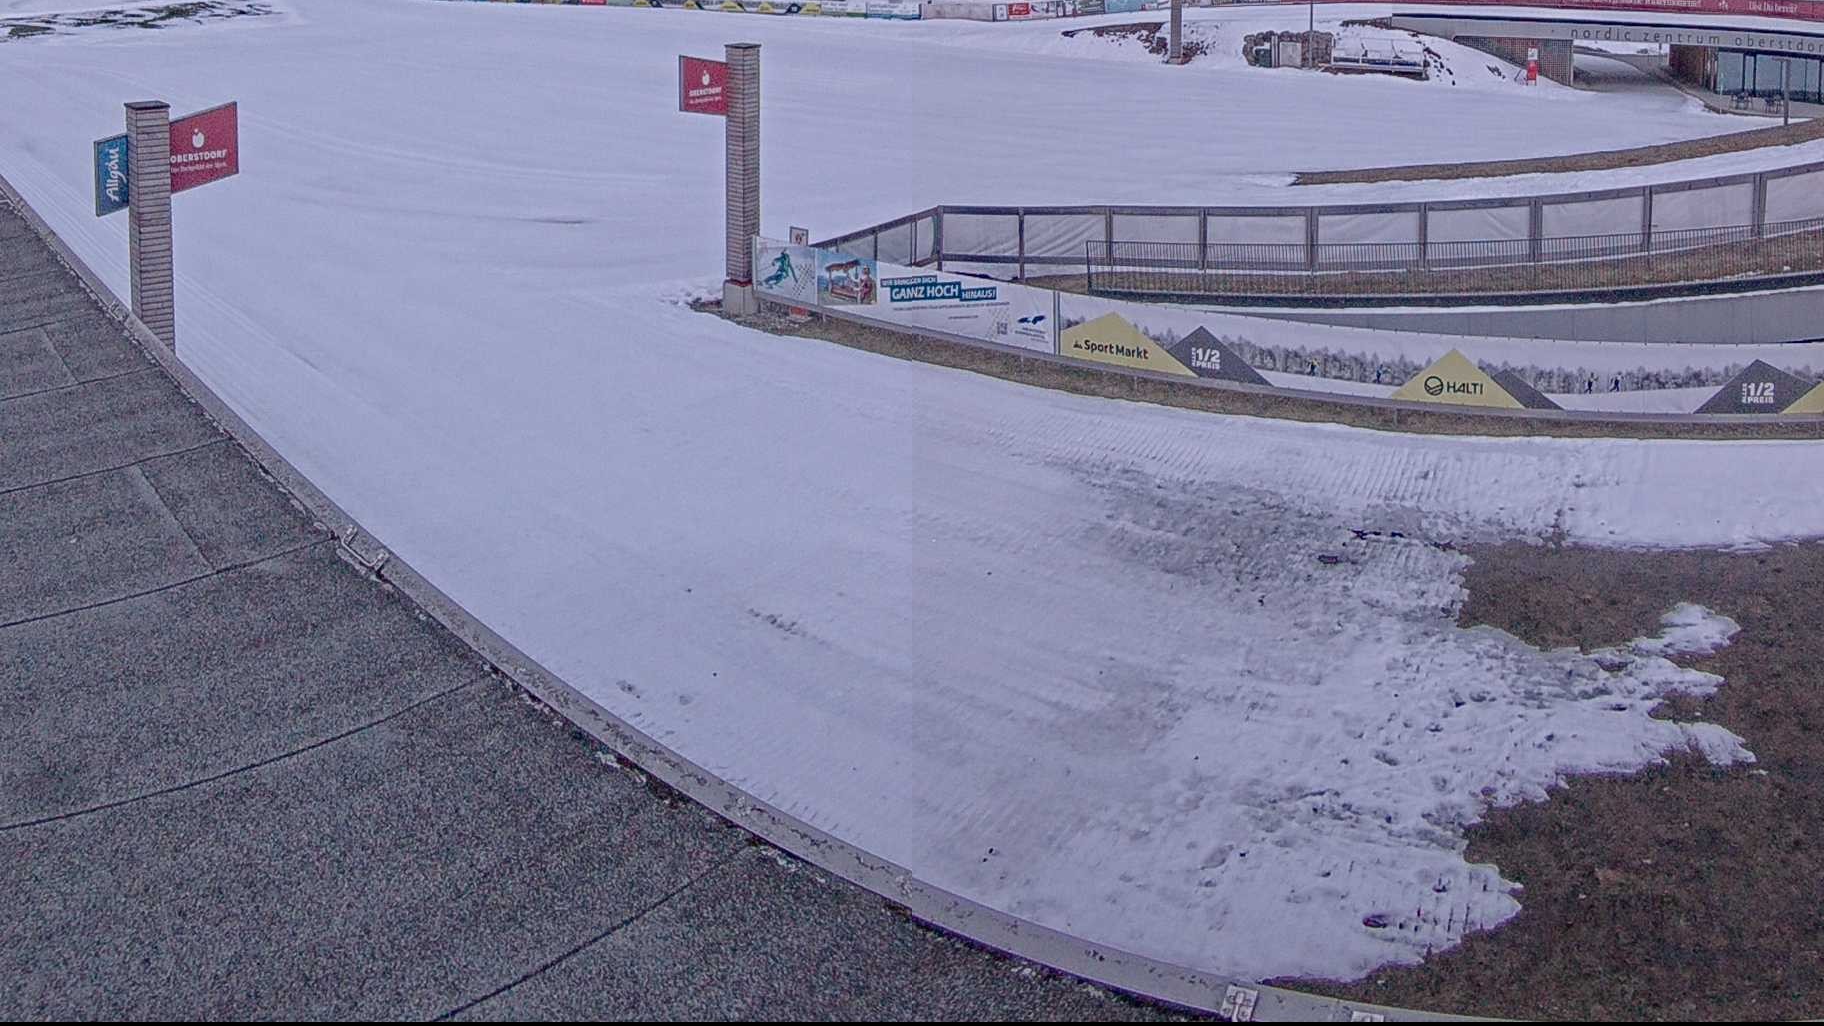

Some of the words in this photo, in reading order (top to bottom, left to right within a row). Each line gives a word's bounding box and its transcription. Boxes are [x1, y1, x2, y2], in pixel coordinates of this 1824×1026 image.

[1570, 27, 1631, 41] nordic
[1643, 31, 1720, 45] zentrum
[169, 149, 228, 164] OBERSTDORF
[926, 284, 959, 298] HOCH
[1196, 347, 1221, 363] 1/2
[1446, 381, 1484, 395] HALTI
[1748, 382, 1775, 396] 1/2
